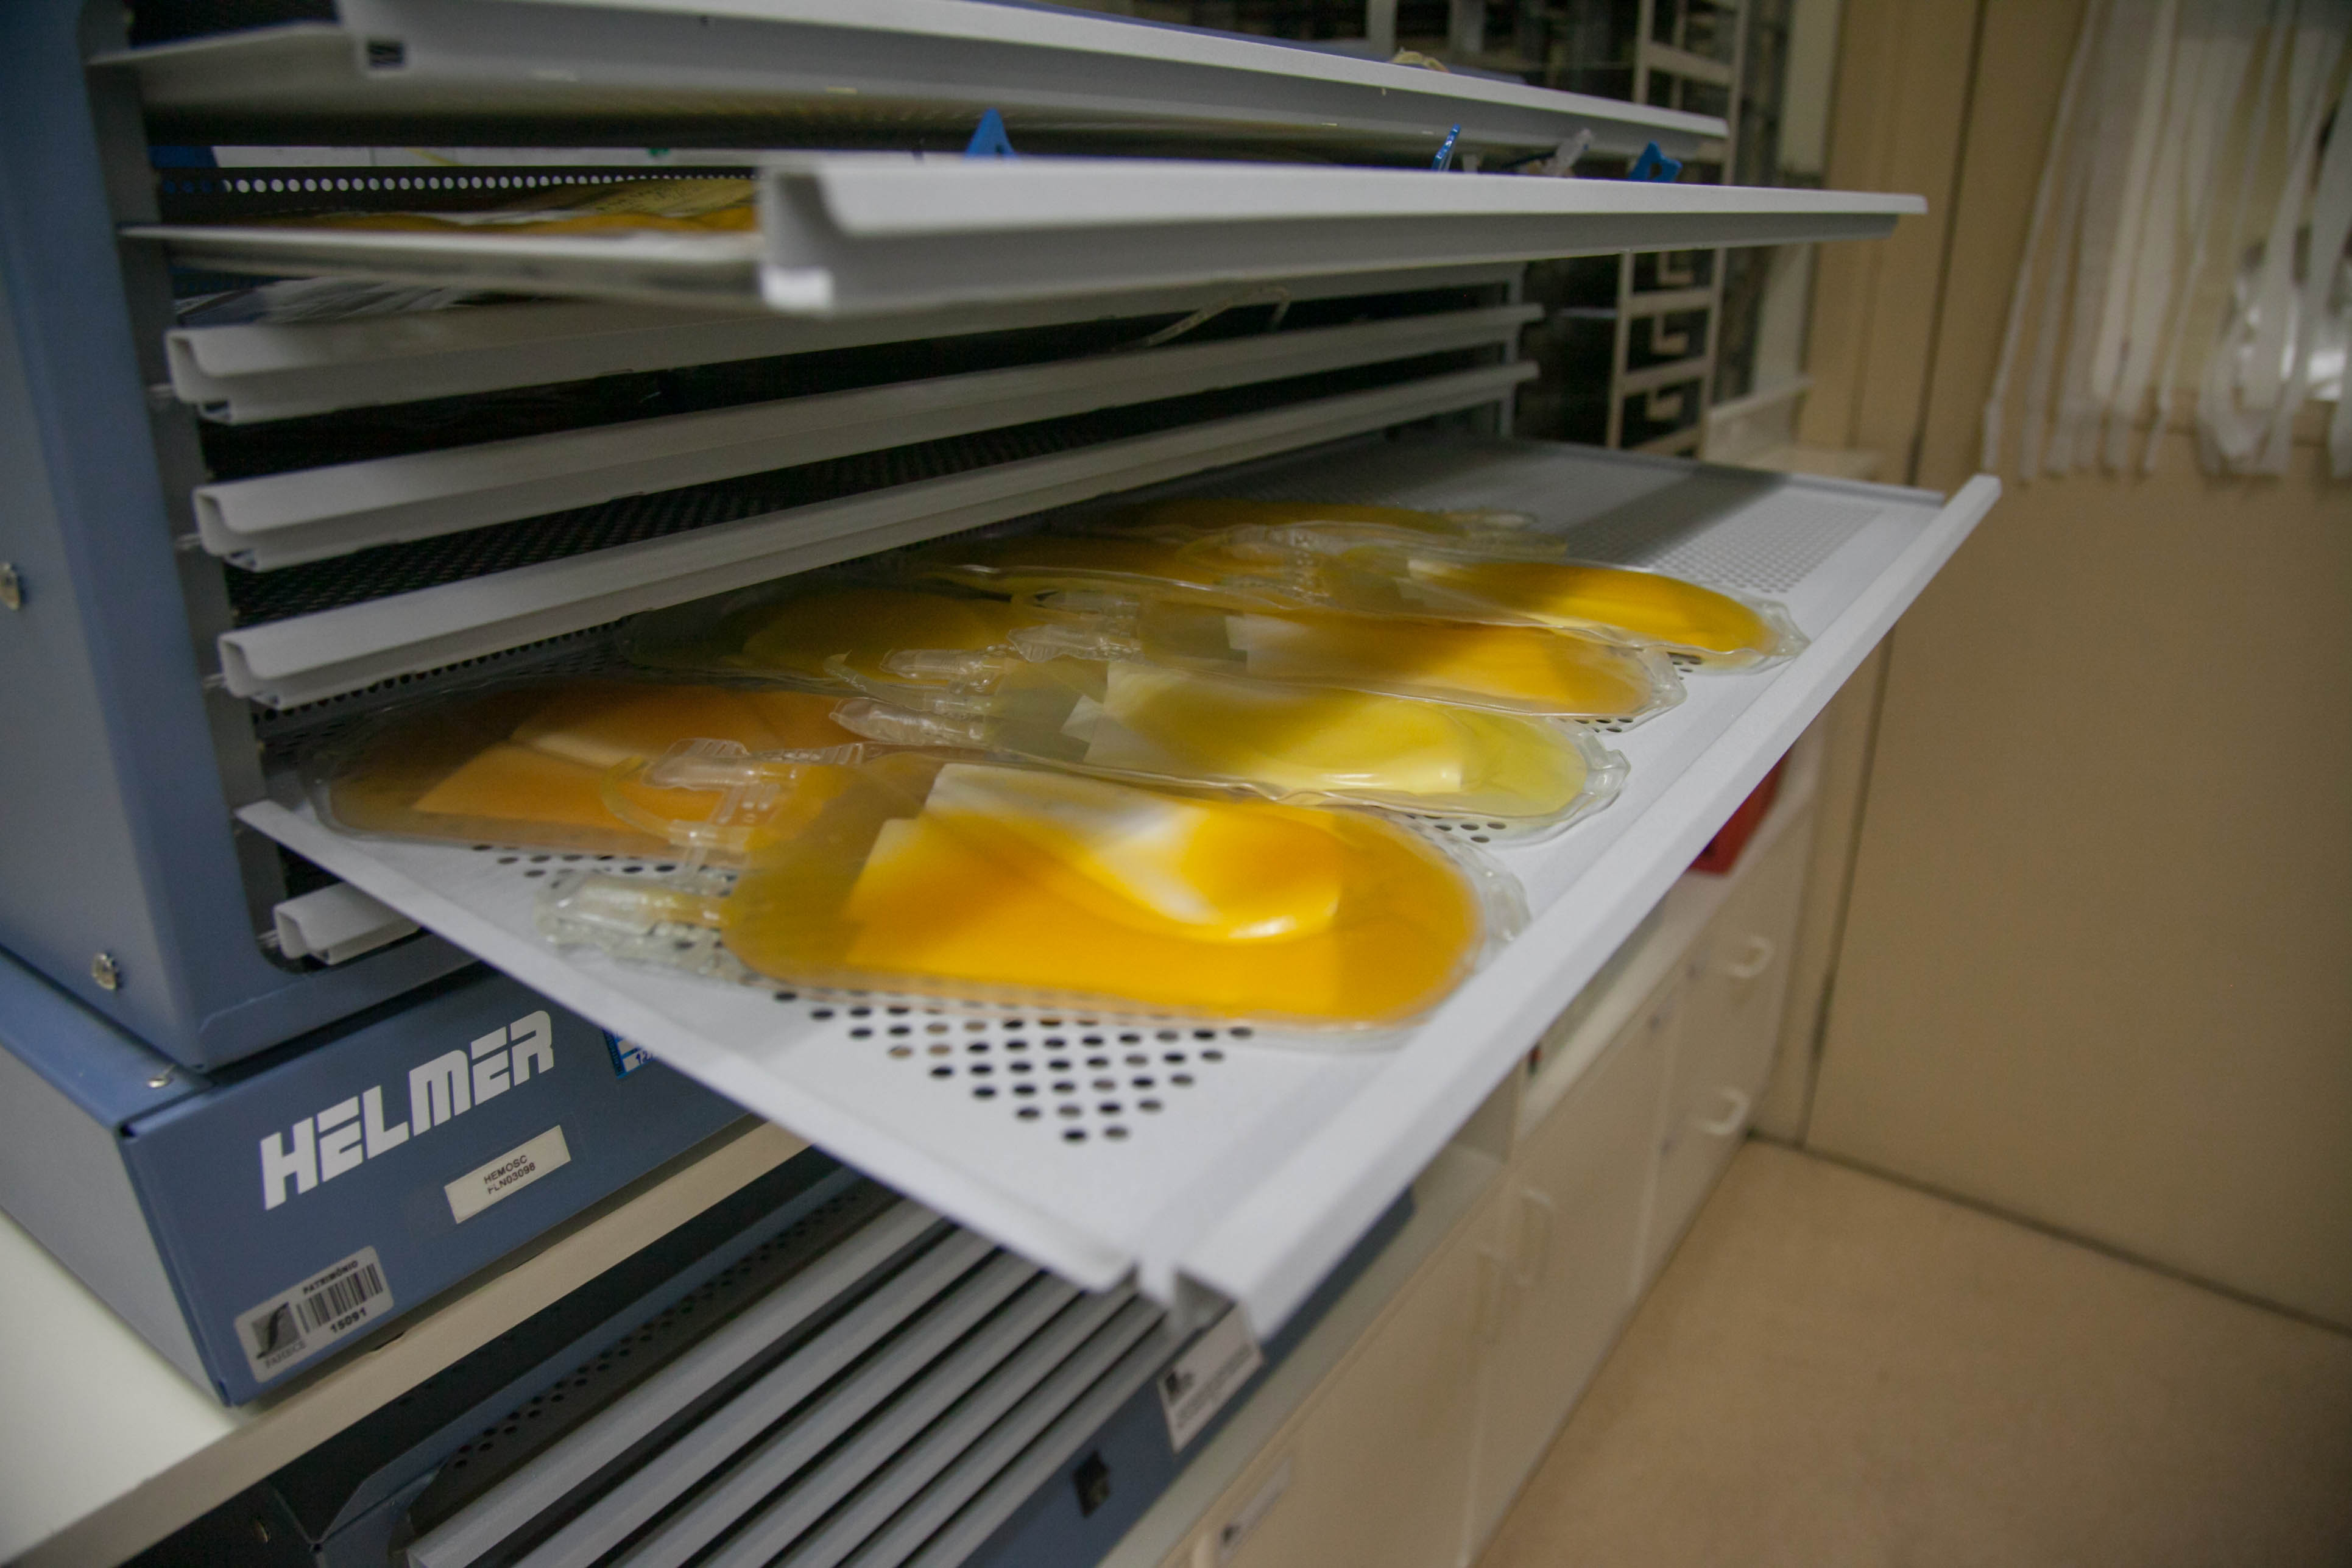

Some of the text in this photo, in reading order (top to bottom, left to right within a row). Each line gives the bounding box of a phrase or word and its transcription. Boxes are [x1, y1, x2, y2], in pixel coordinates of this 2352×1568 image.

[260, 1010, 554, 1210] HELMER
[484, 1155, 528, 1184] HEMOSC
[488, 1162, 536, 1194] FLN03098
[303, 1260, 359, 1294] PATRIMÔNIO
[331, 1307, 367, 1333] 15091
